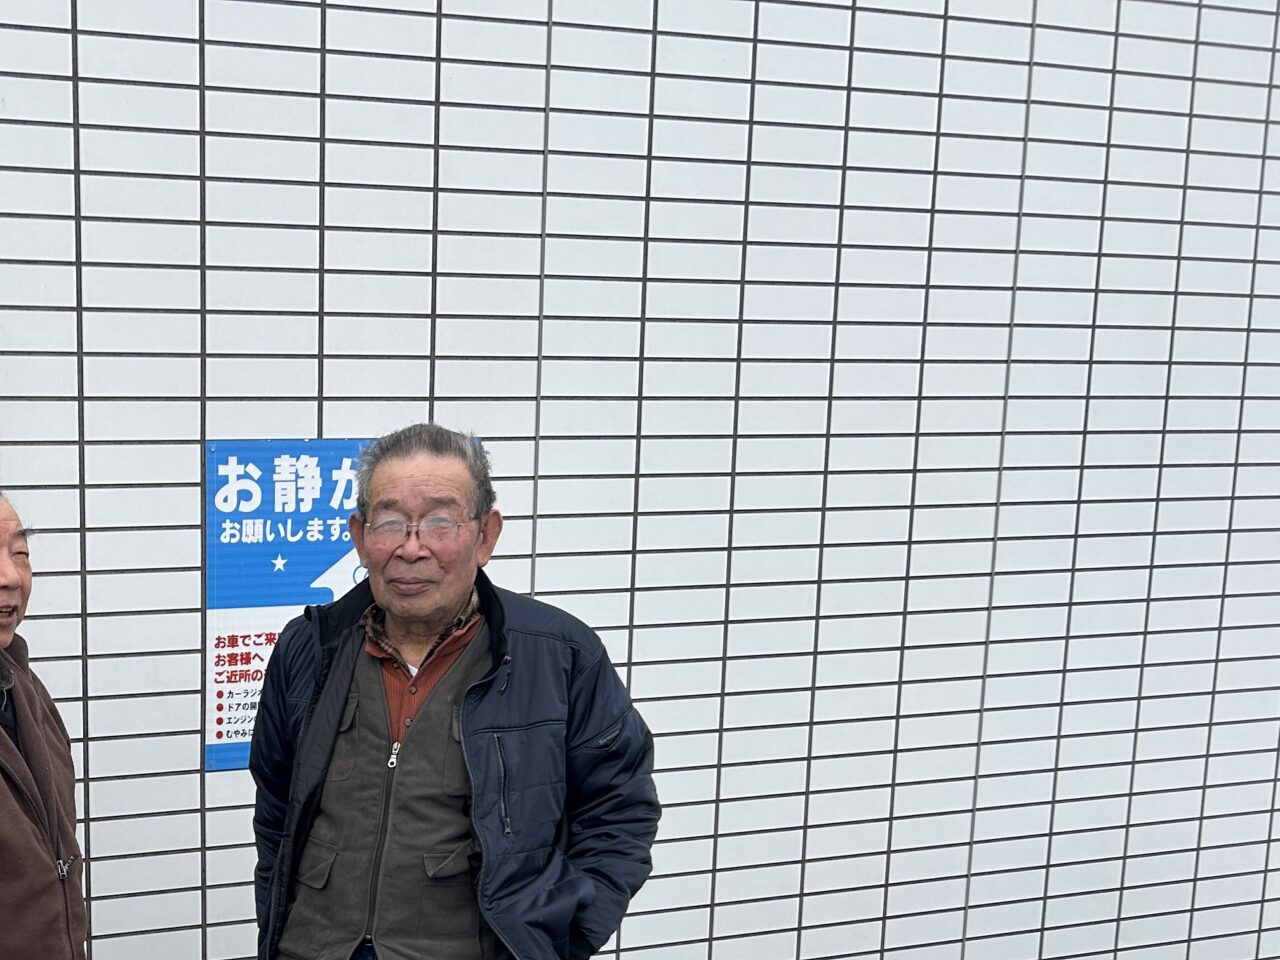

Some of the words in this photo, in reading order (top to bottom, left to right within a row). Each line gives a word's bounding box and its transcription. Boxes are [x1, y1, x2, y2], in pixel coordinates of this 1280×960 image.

[219, 517, 351, 544] お願いします。
[214, 632, 282, 649] お車でご来
[214, 652, 265, 667] お客様へ
[214, 669, 266, 684] ご近所の
[226, 715, 256, 725] エンジン
